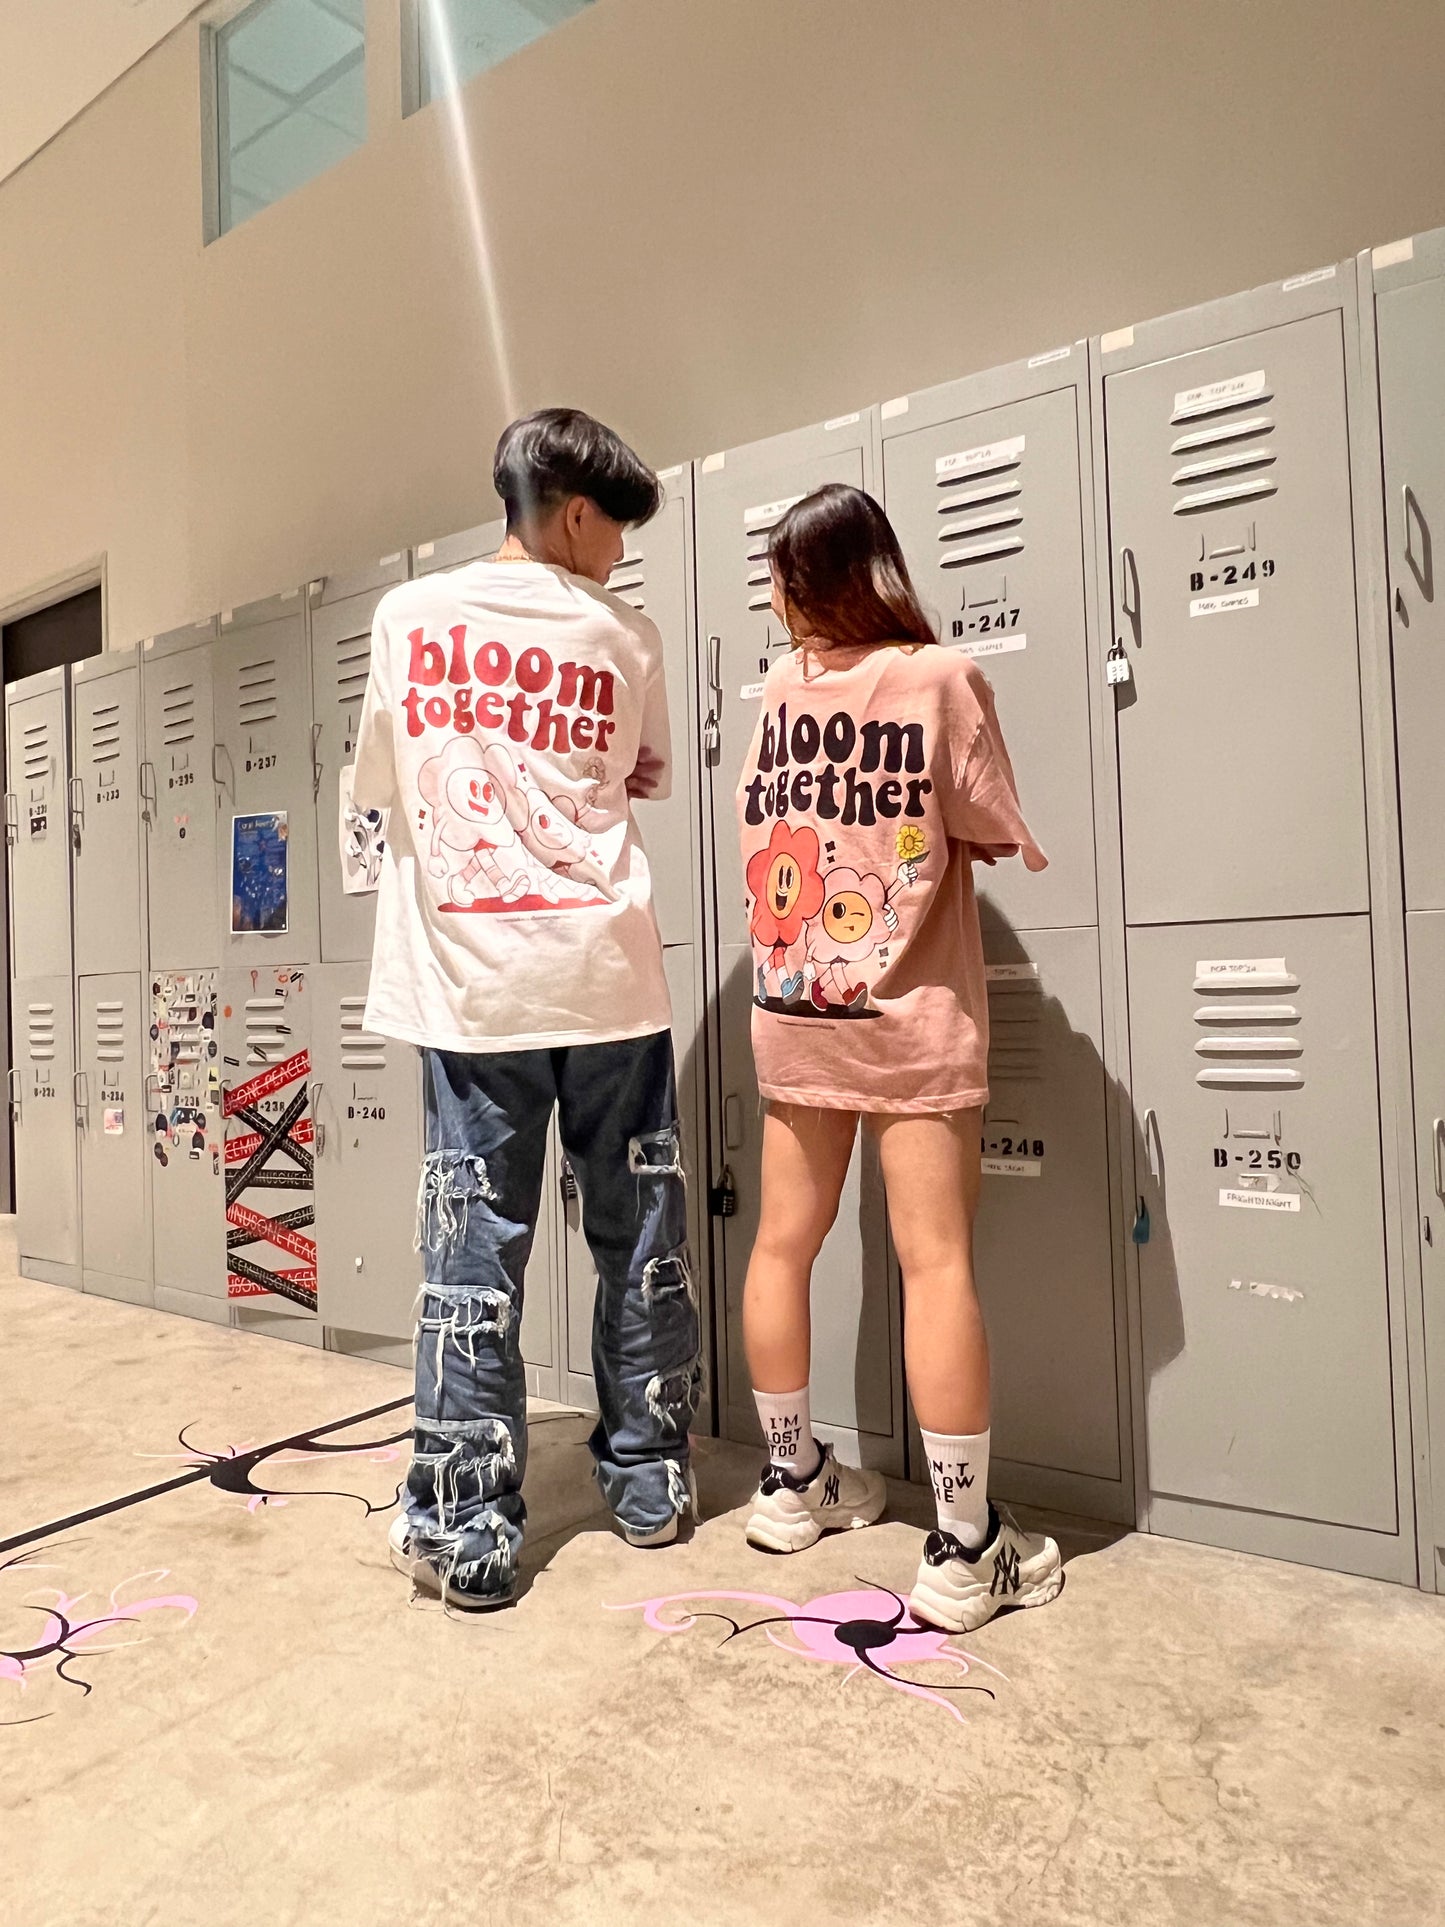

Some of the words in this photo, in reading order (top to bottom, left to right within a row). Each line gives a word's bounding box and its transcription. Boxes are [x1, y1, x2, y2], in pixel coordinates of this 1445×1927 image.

[1190, 560, 1275, 591] B-249
[952, 609, 1020, 638] B-247
[407, 624, 614, 716] bloom
[401, 686, 616, 754] together
[757, 702, 925, 774] bloom
[245, 755, 277, 772] B-237
[745, 763, 933, 826] together
[347, 1106, 386, 1120] B-240
[1213, 1148, 1301, 1170] B-250
[769, 1413, 799, 1430] I'M
[770, 1443, 798, 1457] TOO
